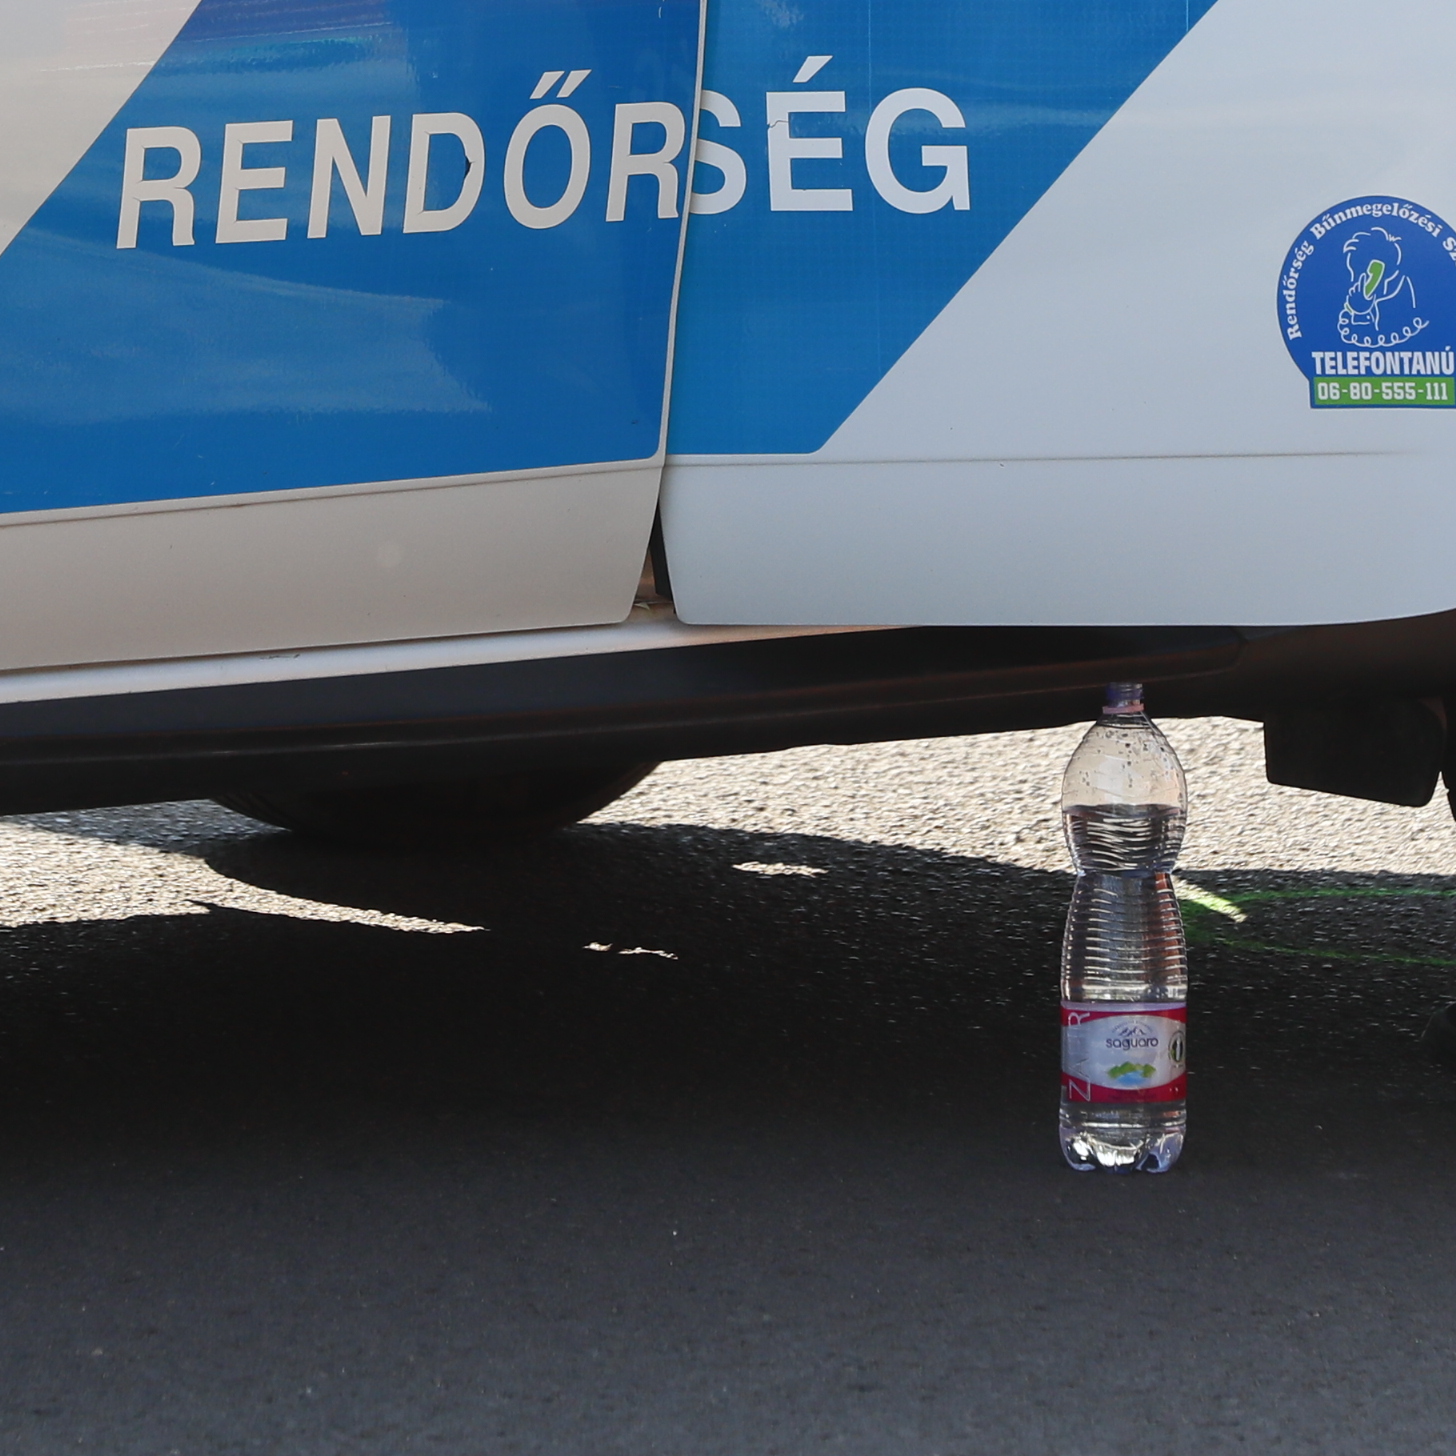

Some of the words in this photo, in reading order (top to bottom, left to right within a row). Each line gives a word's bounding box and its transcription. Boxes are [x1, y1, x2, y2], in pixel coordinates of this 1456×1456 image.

[115, 54, 972, 250] RENDŐRSÉG
[1309, 202, 1444, 240] Bűnmegelőzési
[1282, 240, 1314, 340] Rendőrség
[1311, 346, 1455, 375] TELEFONTANÚ
[1317, 382, 1448, 401] 06-80-555-111
[1106, 1037, 1159, 1051] saguaro
